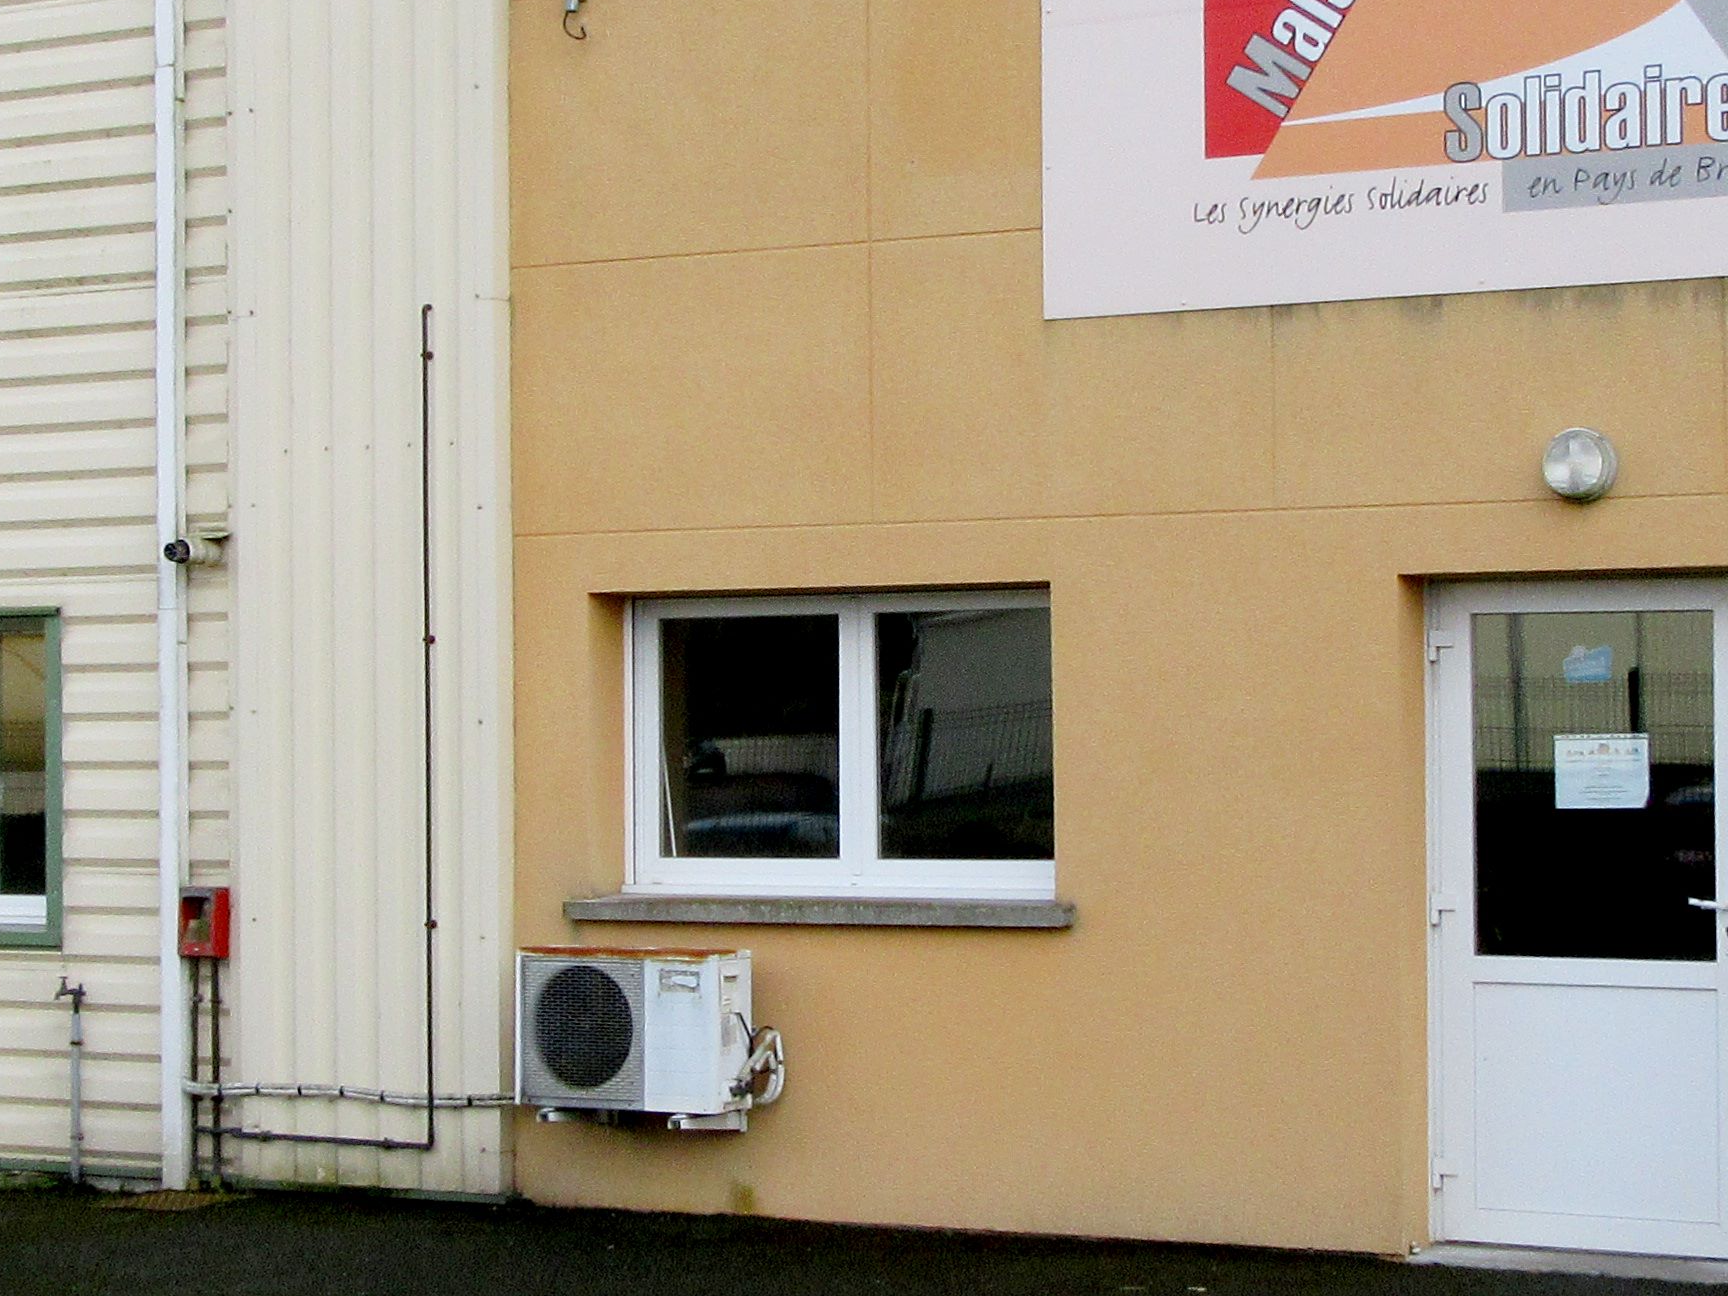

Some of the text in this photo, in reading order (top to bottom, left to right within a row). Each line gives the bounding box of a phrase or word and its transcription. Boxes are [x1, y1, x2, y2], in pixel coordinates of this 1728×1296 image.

[1193, 202, 1228, 225] Les
[1527, 176, 1564, 199] en
[1573, 167, 1636, 205] Pays
[1648, 157, 1682, 188] de
